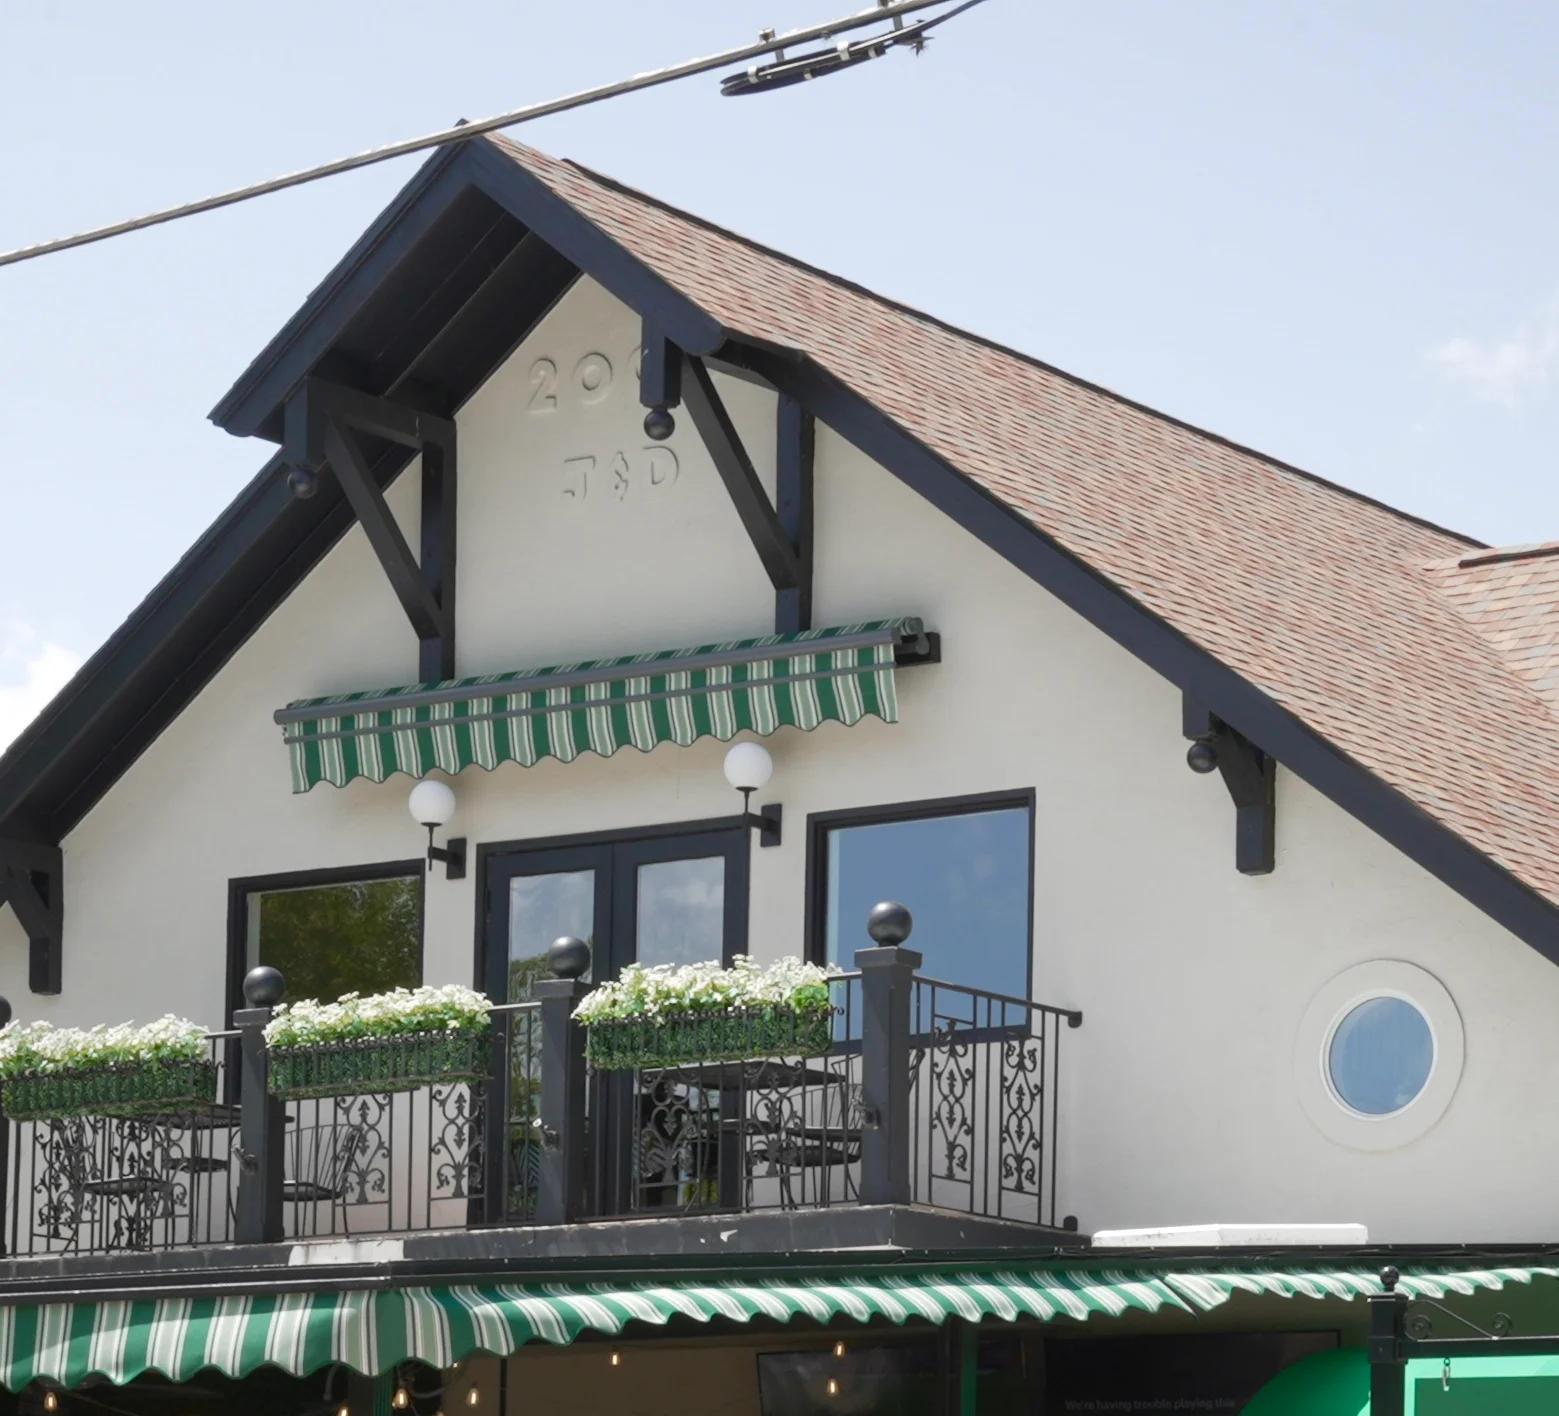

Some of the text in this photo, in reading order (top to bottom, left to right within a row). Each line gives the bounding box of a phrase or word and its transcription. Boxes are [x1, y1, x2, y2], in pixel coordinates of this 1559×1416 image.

[527, 345, 641, 413] 20
[1065, 1397, 1236, 1412] We're having trouble playing this
